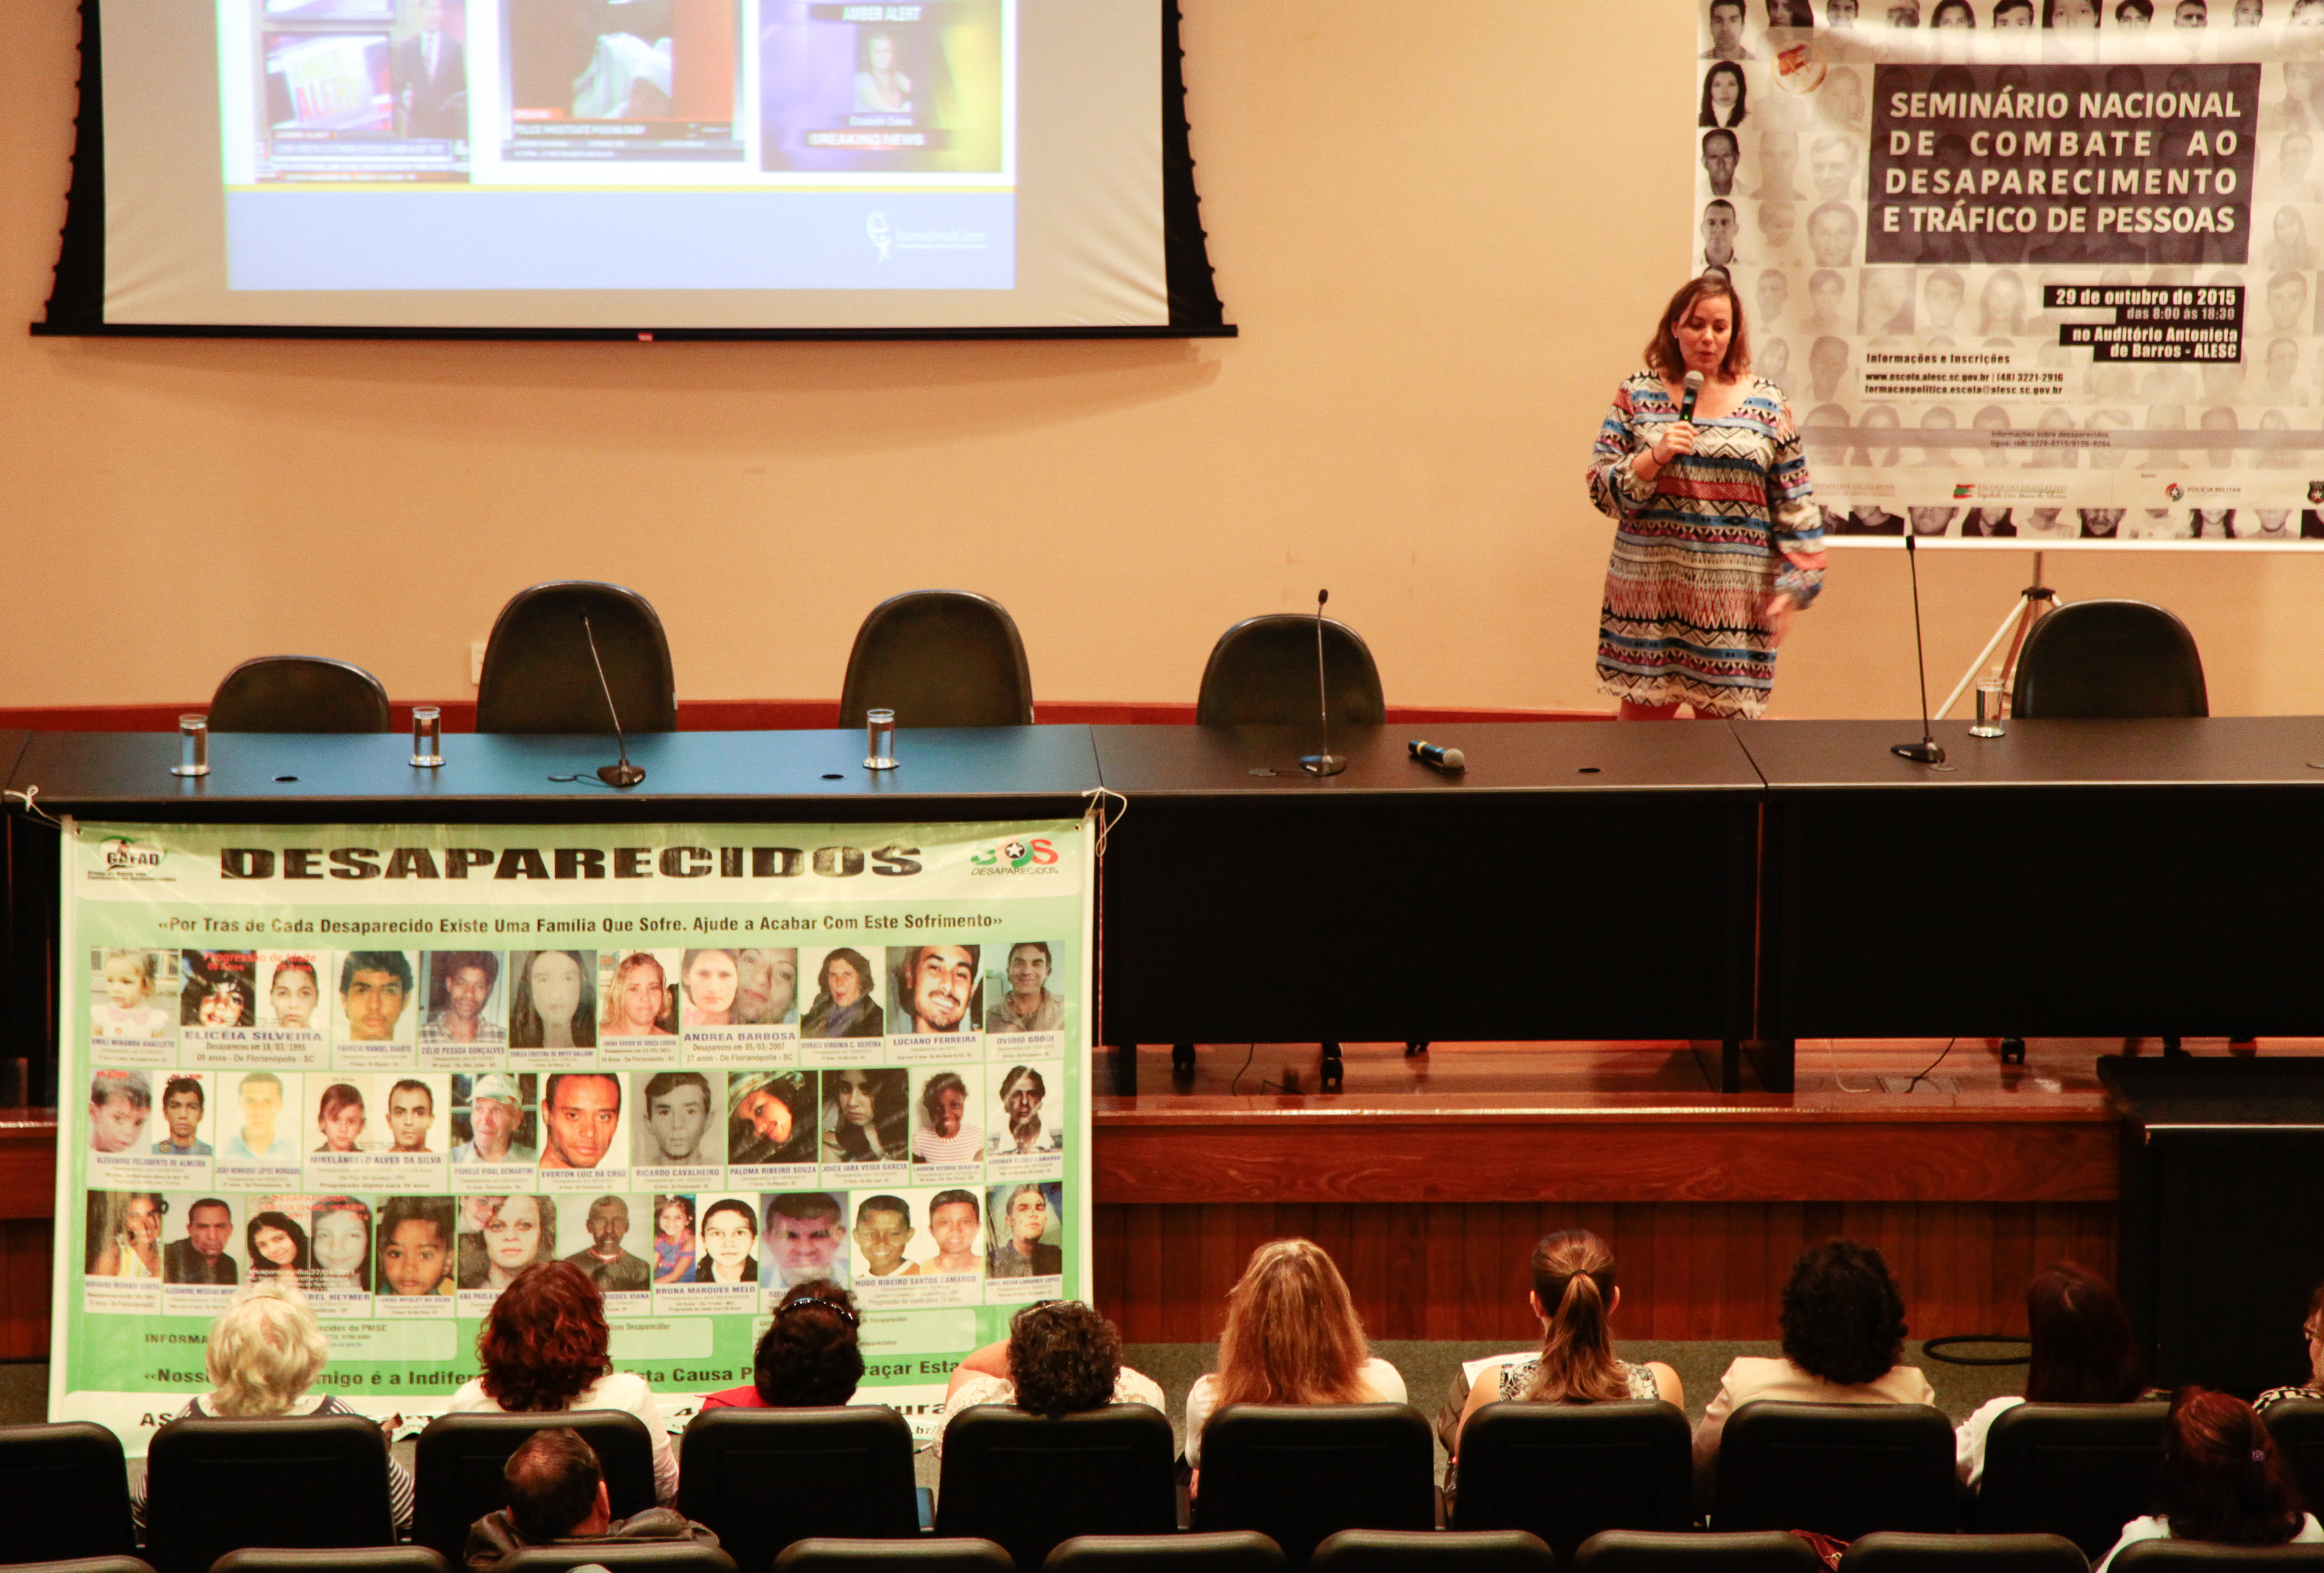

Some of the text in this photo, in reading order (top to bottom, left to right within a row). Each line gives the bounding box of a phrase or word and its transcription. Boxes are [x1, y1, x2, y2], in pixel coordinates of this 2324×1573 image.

[886, 7, 921, 21] ALERT
[296, 76, 360, 123] ALERT
[1890, 85, 2241, 118] SEMINÁRIO NACIONAL
[809, 133, 924, 145] BREAKING NEWS
[1890, 130, 2237, 157] DE COMBATE AO
[1886, 168, 2237, 195] DESAPARECIMENTO
[1883, 199, 2234, 233] E TRÁFICO DE PESSOAS
[2056, 288, 2236, 306] 29 de outubro de 2015
[2126, 307, 2149, 320] das
[2153, 307, 2180, 320] 8:00
[2202, 307, 2235, 320] 18:30
[2072, 326, 2237, 342] no Auditório Antonieta
[2110, 343, 2128, 357] de
[2133, 343, 2181, 358] Barros
[2194, 344, 2237, 358] ALESC
[1867, 354, 1937, 366] Informações
[1951, 354, 2010, 366] Inscrições
[1997, 373, 2015, 382] (48)
[971, 837, 1059, 868] SOS
[221, 846, 923, 880] DESAPARECIDOS
[971, 867, 1059, 876] DESAPARECIDOS
[245, 919, 265, 932] de
[271, 918, 314, 933] Cada
[320, 919, 433, 937] Desaparecido
[439, 919, 488, 933] Existe
[494, 919, 530, 933] Uma
[536, 916, 596, 933] Família
[603, 917, 634, 934] Que
[639, 916, 687, 932] Sofre.
[693, 916, 738, 935] Ajude
[744, 921, 754, 931] a
[760, 915, 817, 931] Acabar
[823, 916, 858, 930] Com
[864, 914, 898, 930] Este
[270, 953, 283, 962] de
[185, 1029, 323, 1042] ELICÉIA SILVEIRA
[684, 1032, 796, 1042] ANDREA BARBOSA
[206, 1043, 249, 1052] Desapareceu
[693, 1044, 732, 1053] Desapareceu
[246, 1054, 297, 1064] Florianópolis
[732, 1054, 777, 1063] Florianópolis
[371, 1370, 382, 1385] é
[390, 1375, 401, 1385] a
[673, 1368, 733, 1382] Causa
